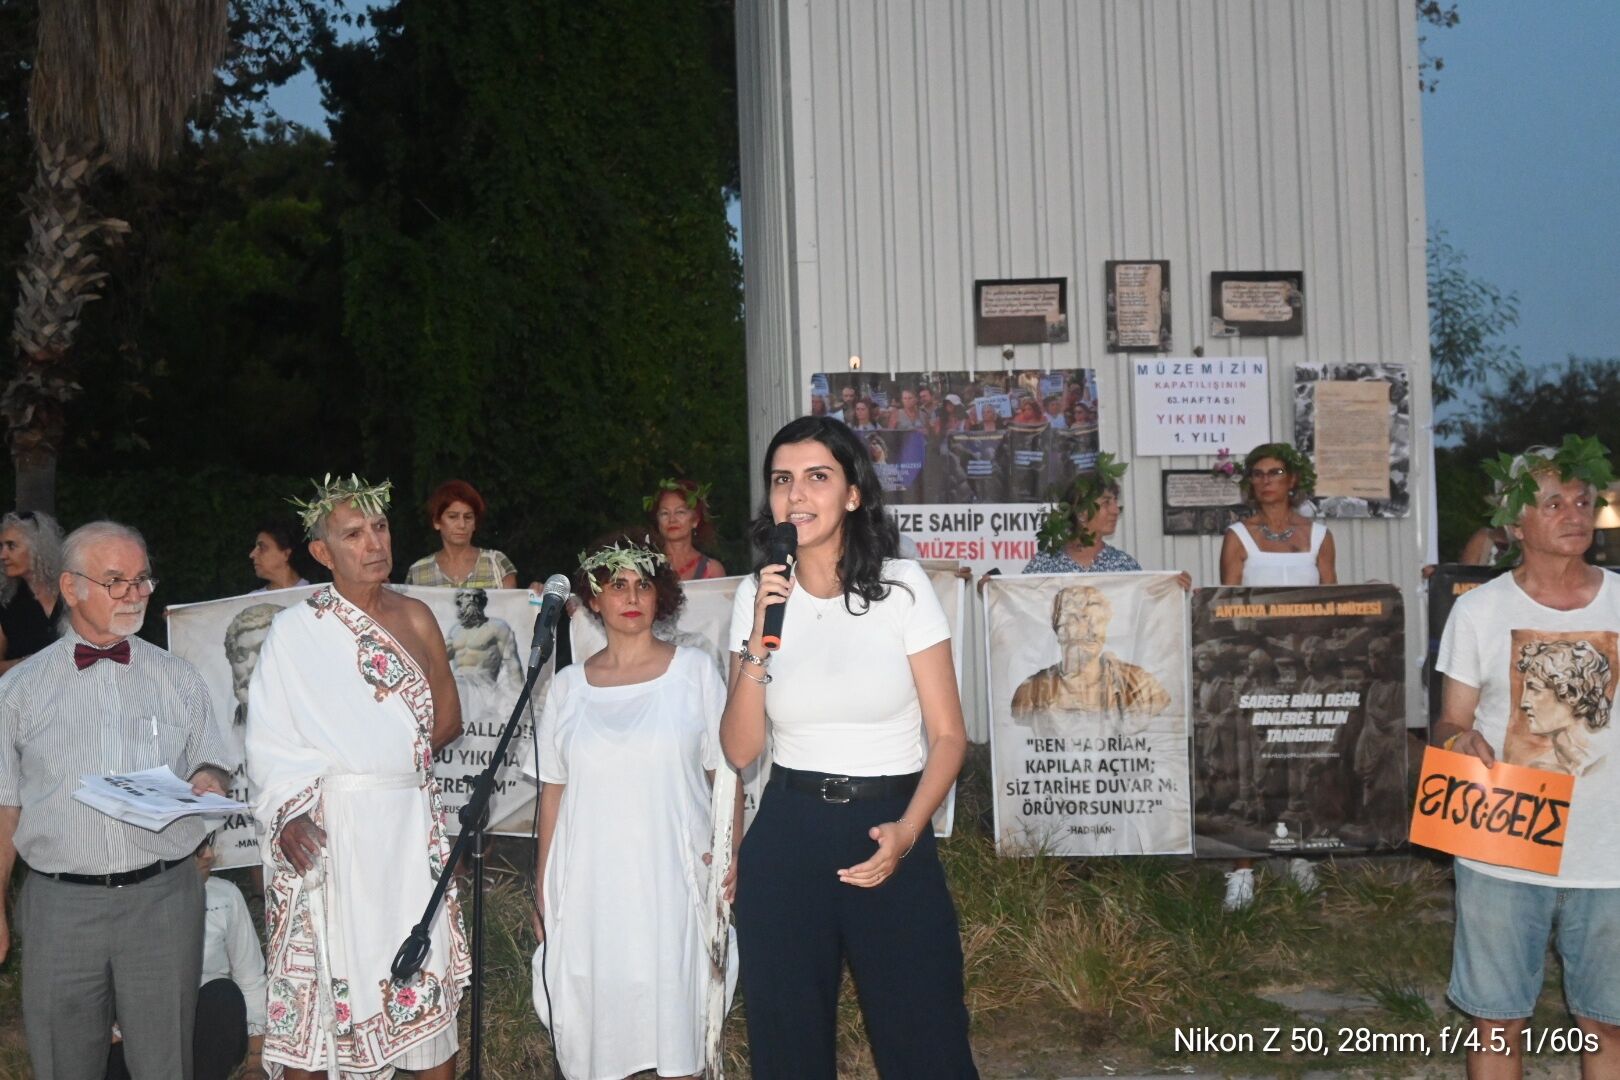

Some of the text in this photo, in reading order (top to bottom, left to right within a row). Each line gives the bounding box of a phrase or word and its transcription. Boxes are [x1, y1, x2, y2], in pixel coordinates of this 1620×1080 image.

[1136, 360, 1264, 376] MÜZEMİZİN
[1182, 396, 1236, 405] HAFTASI
[1156, 413, 1247, 425] YIKIMININ
[1174, 432, 1226, 443] 1. YILI
[929, 508, 985, 533] SAHİP
[915, 536, 985, 561] MÜZESİ
[1215, 603, 1267, 618] ANTALYA
[1239, 691, 1361, 709] SADECE BİNA DEĞİL
[1251, 710, 1350, 726] BİNLERCE YILIN
[1026, 738, 1066, 753] "BEN
[1025, 757, 1156, 776] KAPILAR AÇTIM;
[1006, 778, 1031, 796] SİZ
[1034, 777, 1091, 795] TARİHE
[1096, 778, 1153, 794] DUVAR
